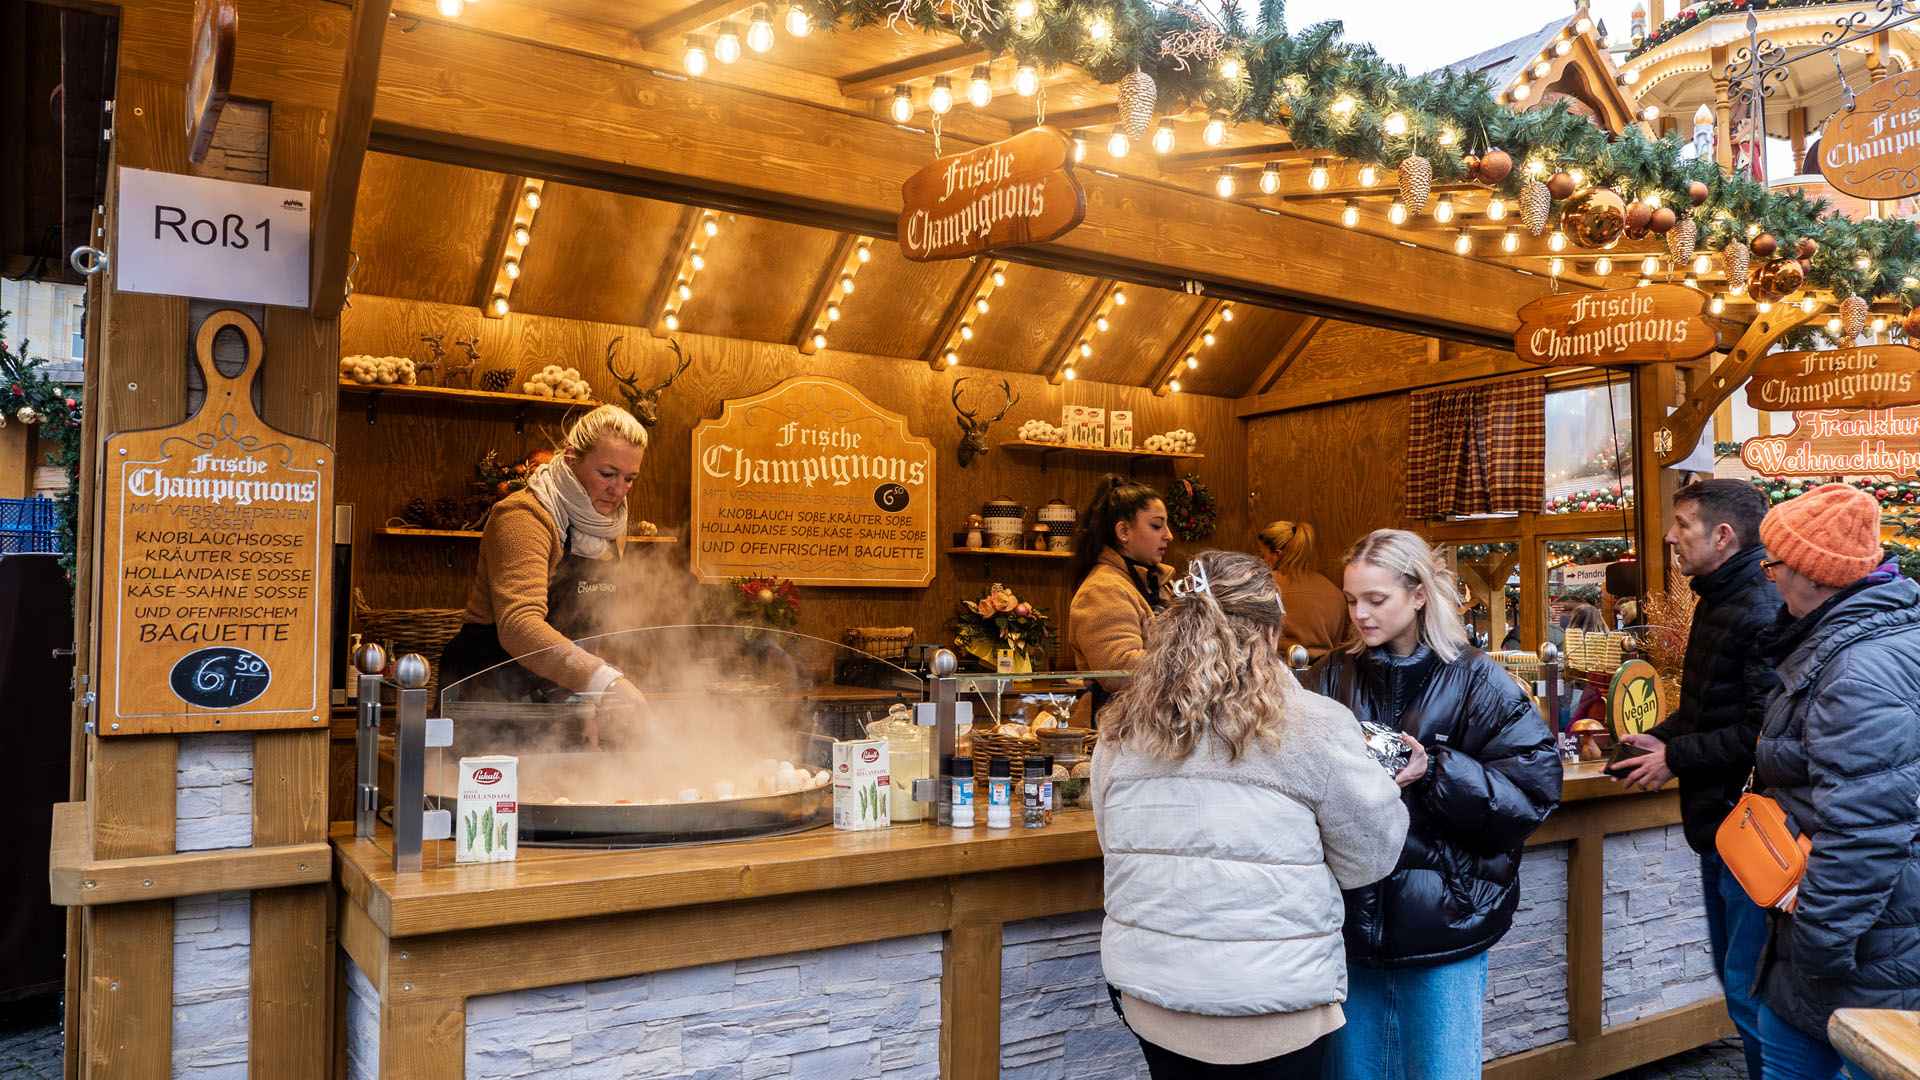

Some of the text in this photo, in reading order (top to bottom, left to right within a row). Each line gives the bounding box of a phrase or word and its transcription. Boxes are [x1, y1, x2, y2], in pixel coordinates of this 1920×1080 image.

[939, 148, 1014, 203] Frische
[908, 177, 1046, 258] Champignons
[1568, 292, 1653, 325] Frische
[1530, 317, 1690, 362] Champignons
[1797, 350, 1878, 376] Frische
[1761, 371, 1914, 408] Champignons
[776, 422, 862, 450] Frische
[188, 453, 268, 477] Frische
[703, 444, 927, 488] Champignons
[128, 467, 316, 505] Champignons
[703, 489, 726, 500] MIT
[130, 504, 310, 520] MIT VERSCHIEDENEN
[718, 508, 793, 521] KNOBLAUCH
[188, 518, 254, 530] SOSSEN
[702, 522, 786, 536] HOLLANDAISE
[136, 531, 304, 547] KNOBLAUCHSOSSE
[146, 547, 294, 564] KRÄUTER SOSSE
[702, 542, 924, 559] UND OFENFRISCHEM BAGUETTE
[125, 567, 312, 582] HOLLANDAISE SOSSE
[1578, 568, 1606, 579] Pfandrü
[127, 583, 309, 599] KÄSE-SAHNE SOSSE
[135, 607, 298, 619] UND OFENFRISCHEM
[140, 622, 290, 643] BAGUETTE
[1625, 700, 1655, 720] vegan
